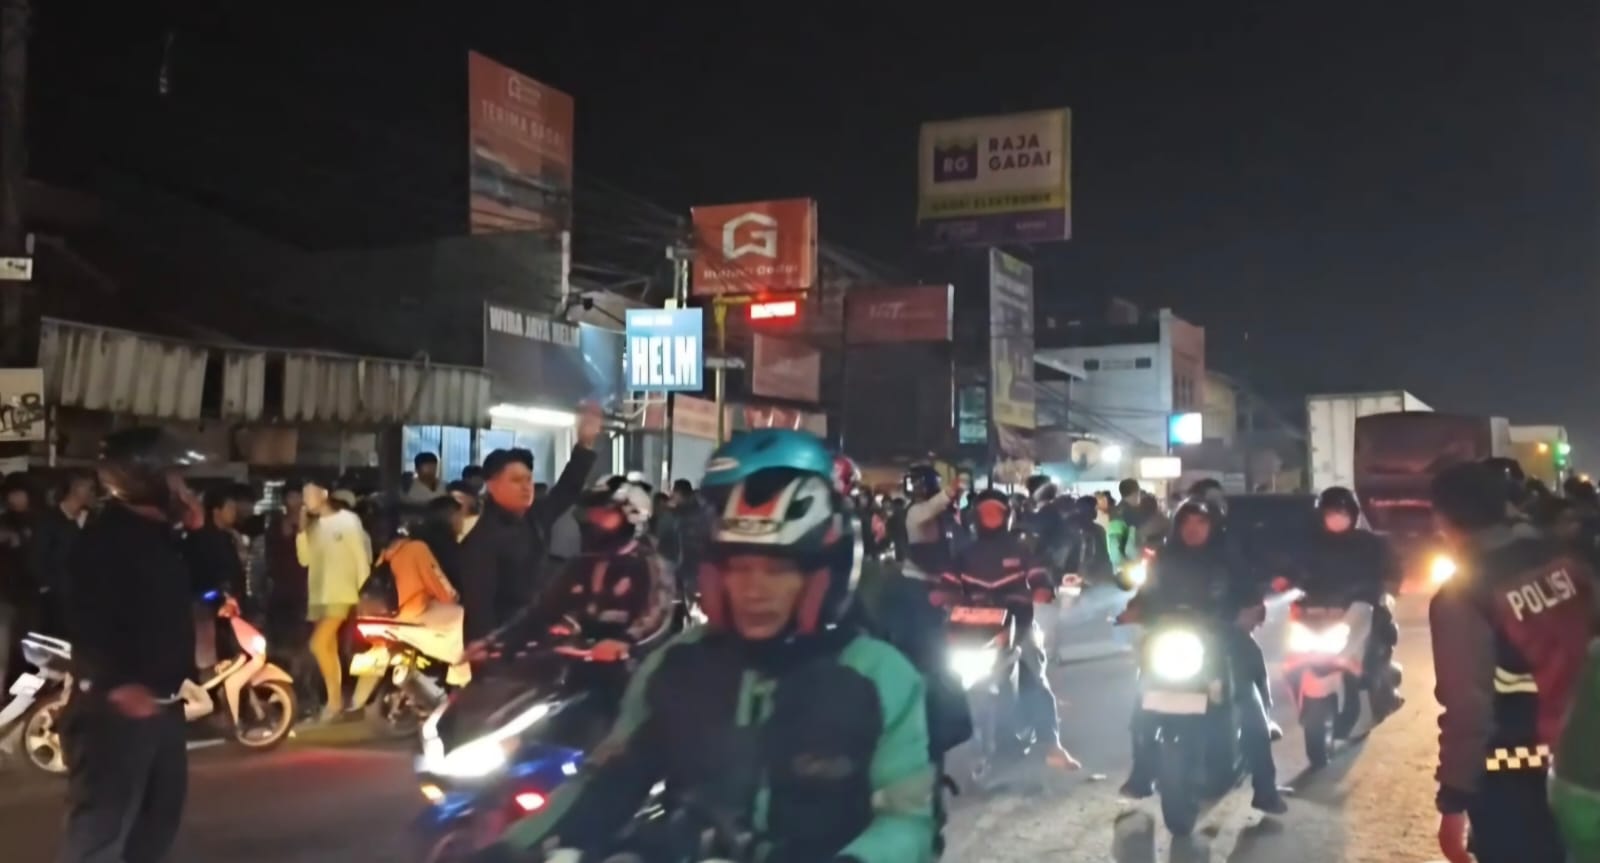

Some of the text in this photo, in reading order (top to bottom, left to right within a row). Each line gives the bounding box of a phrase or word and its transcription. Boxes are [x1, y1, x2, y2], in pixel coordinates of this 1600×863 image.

[988, 133, 1040, 152] RAJA
[943, 156, 969, 173] RG
[988, 151, 1052, 171] GADAI
[631, 335, 697, 385] HELM
[1506, 567, 1577, 622] POLISI
